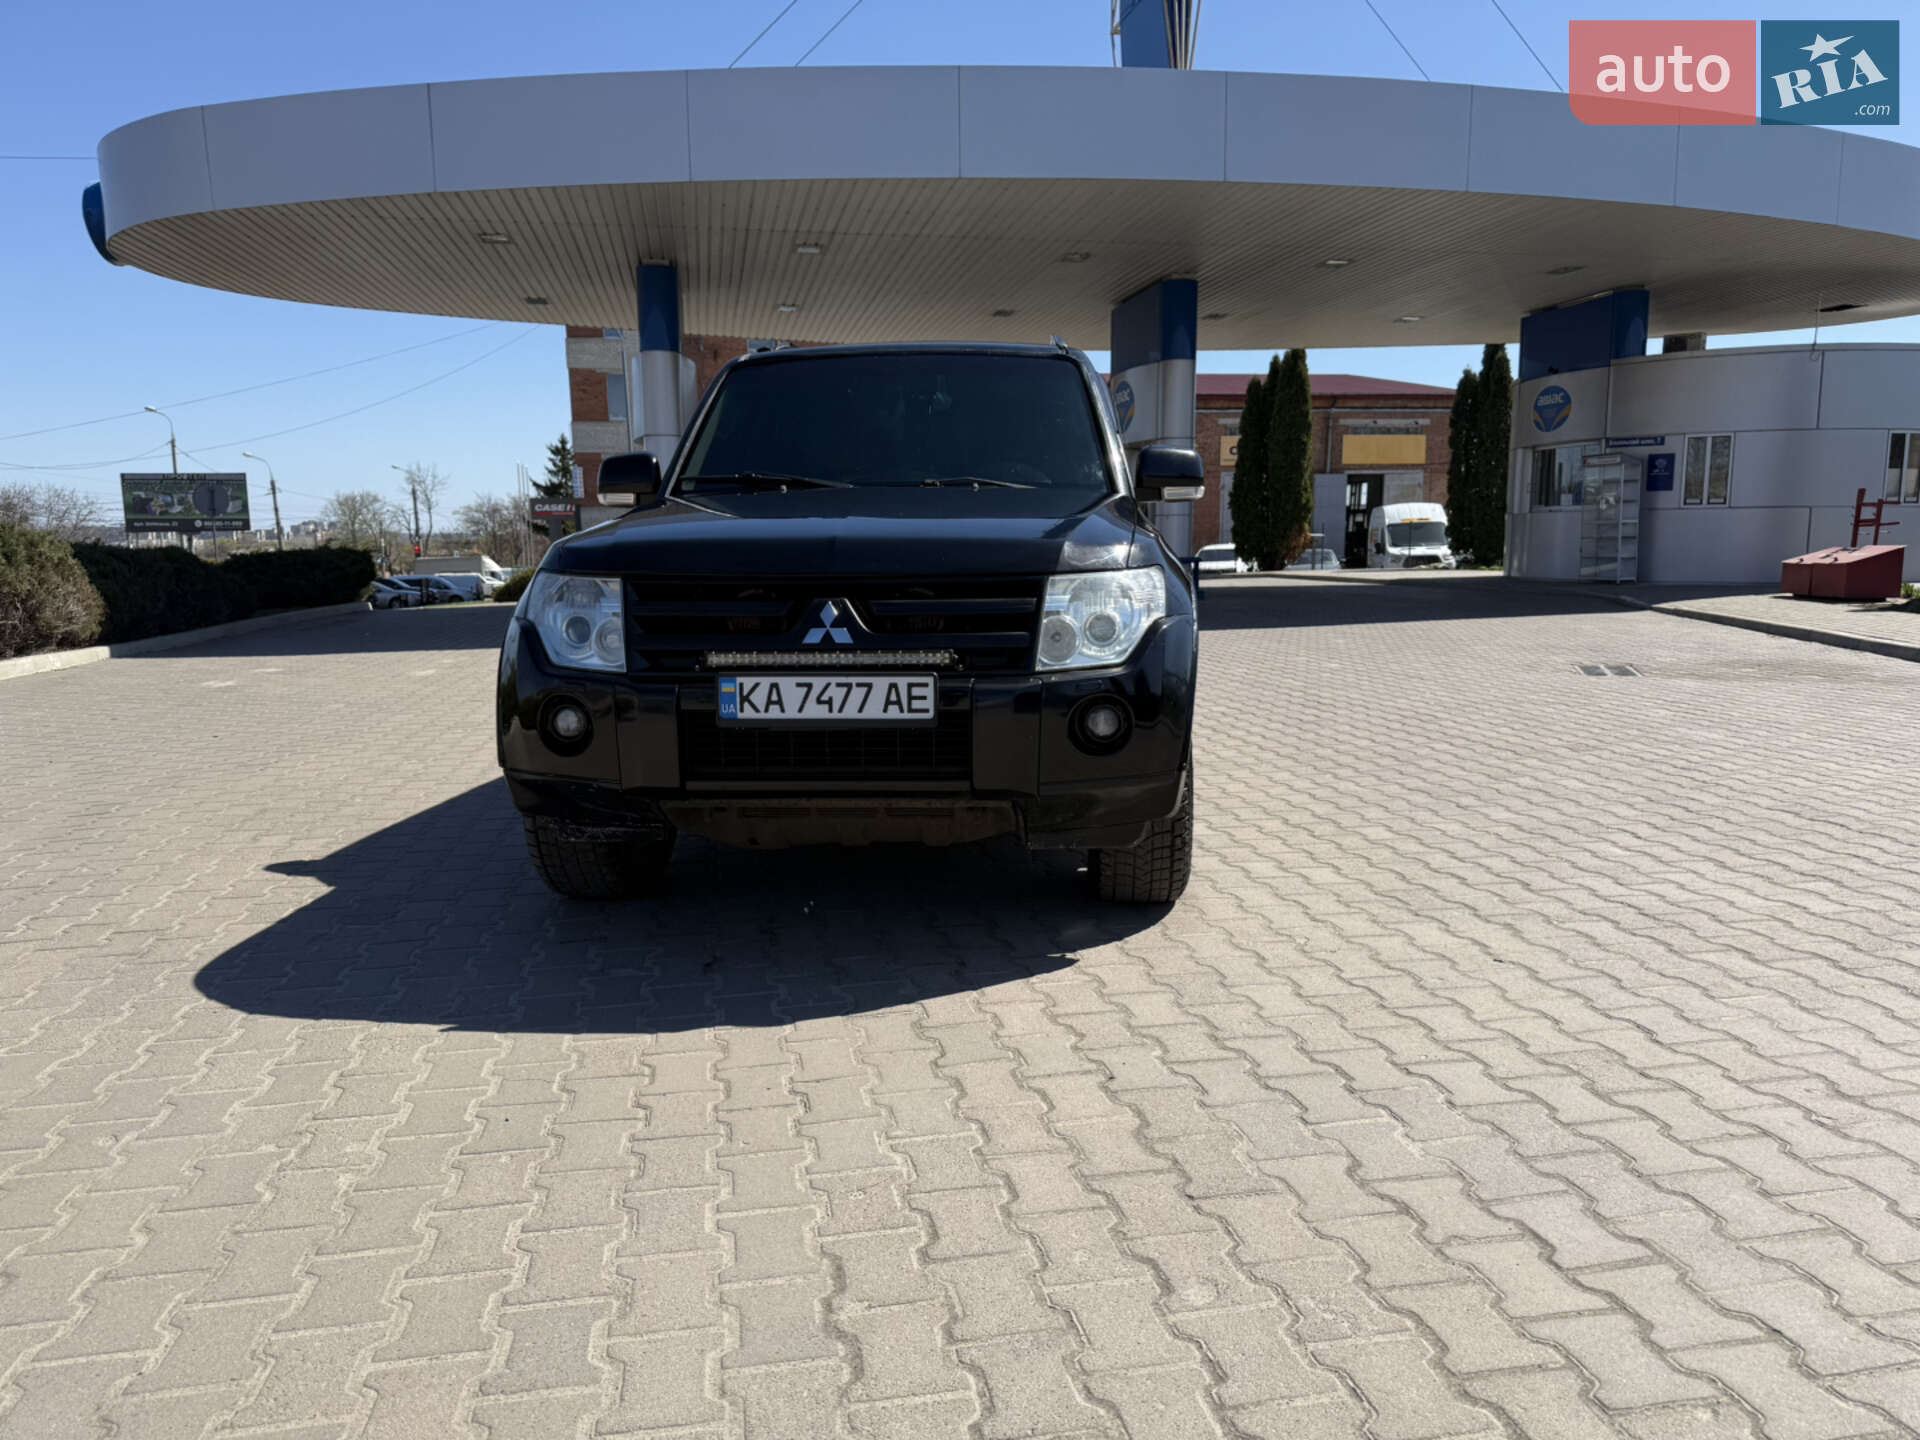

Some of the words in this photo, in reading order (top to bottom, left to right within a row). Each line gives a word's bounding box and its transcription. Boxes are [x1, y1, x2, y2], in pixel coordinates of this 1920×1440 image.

[534, 503, 565, 512] CASE
[738, 682, 786, 714] KA
[795, 682, 873, 714] 7477
[882, 682, 930, 714] AE
[721, 703, 736, 713] UA
